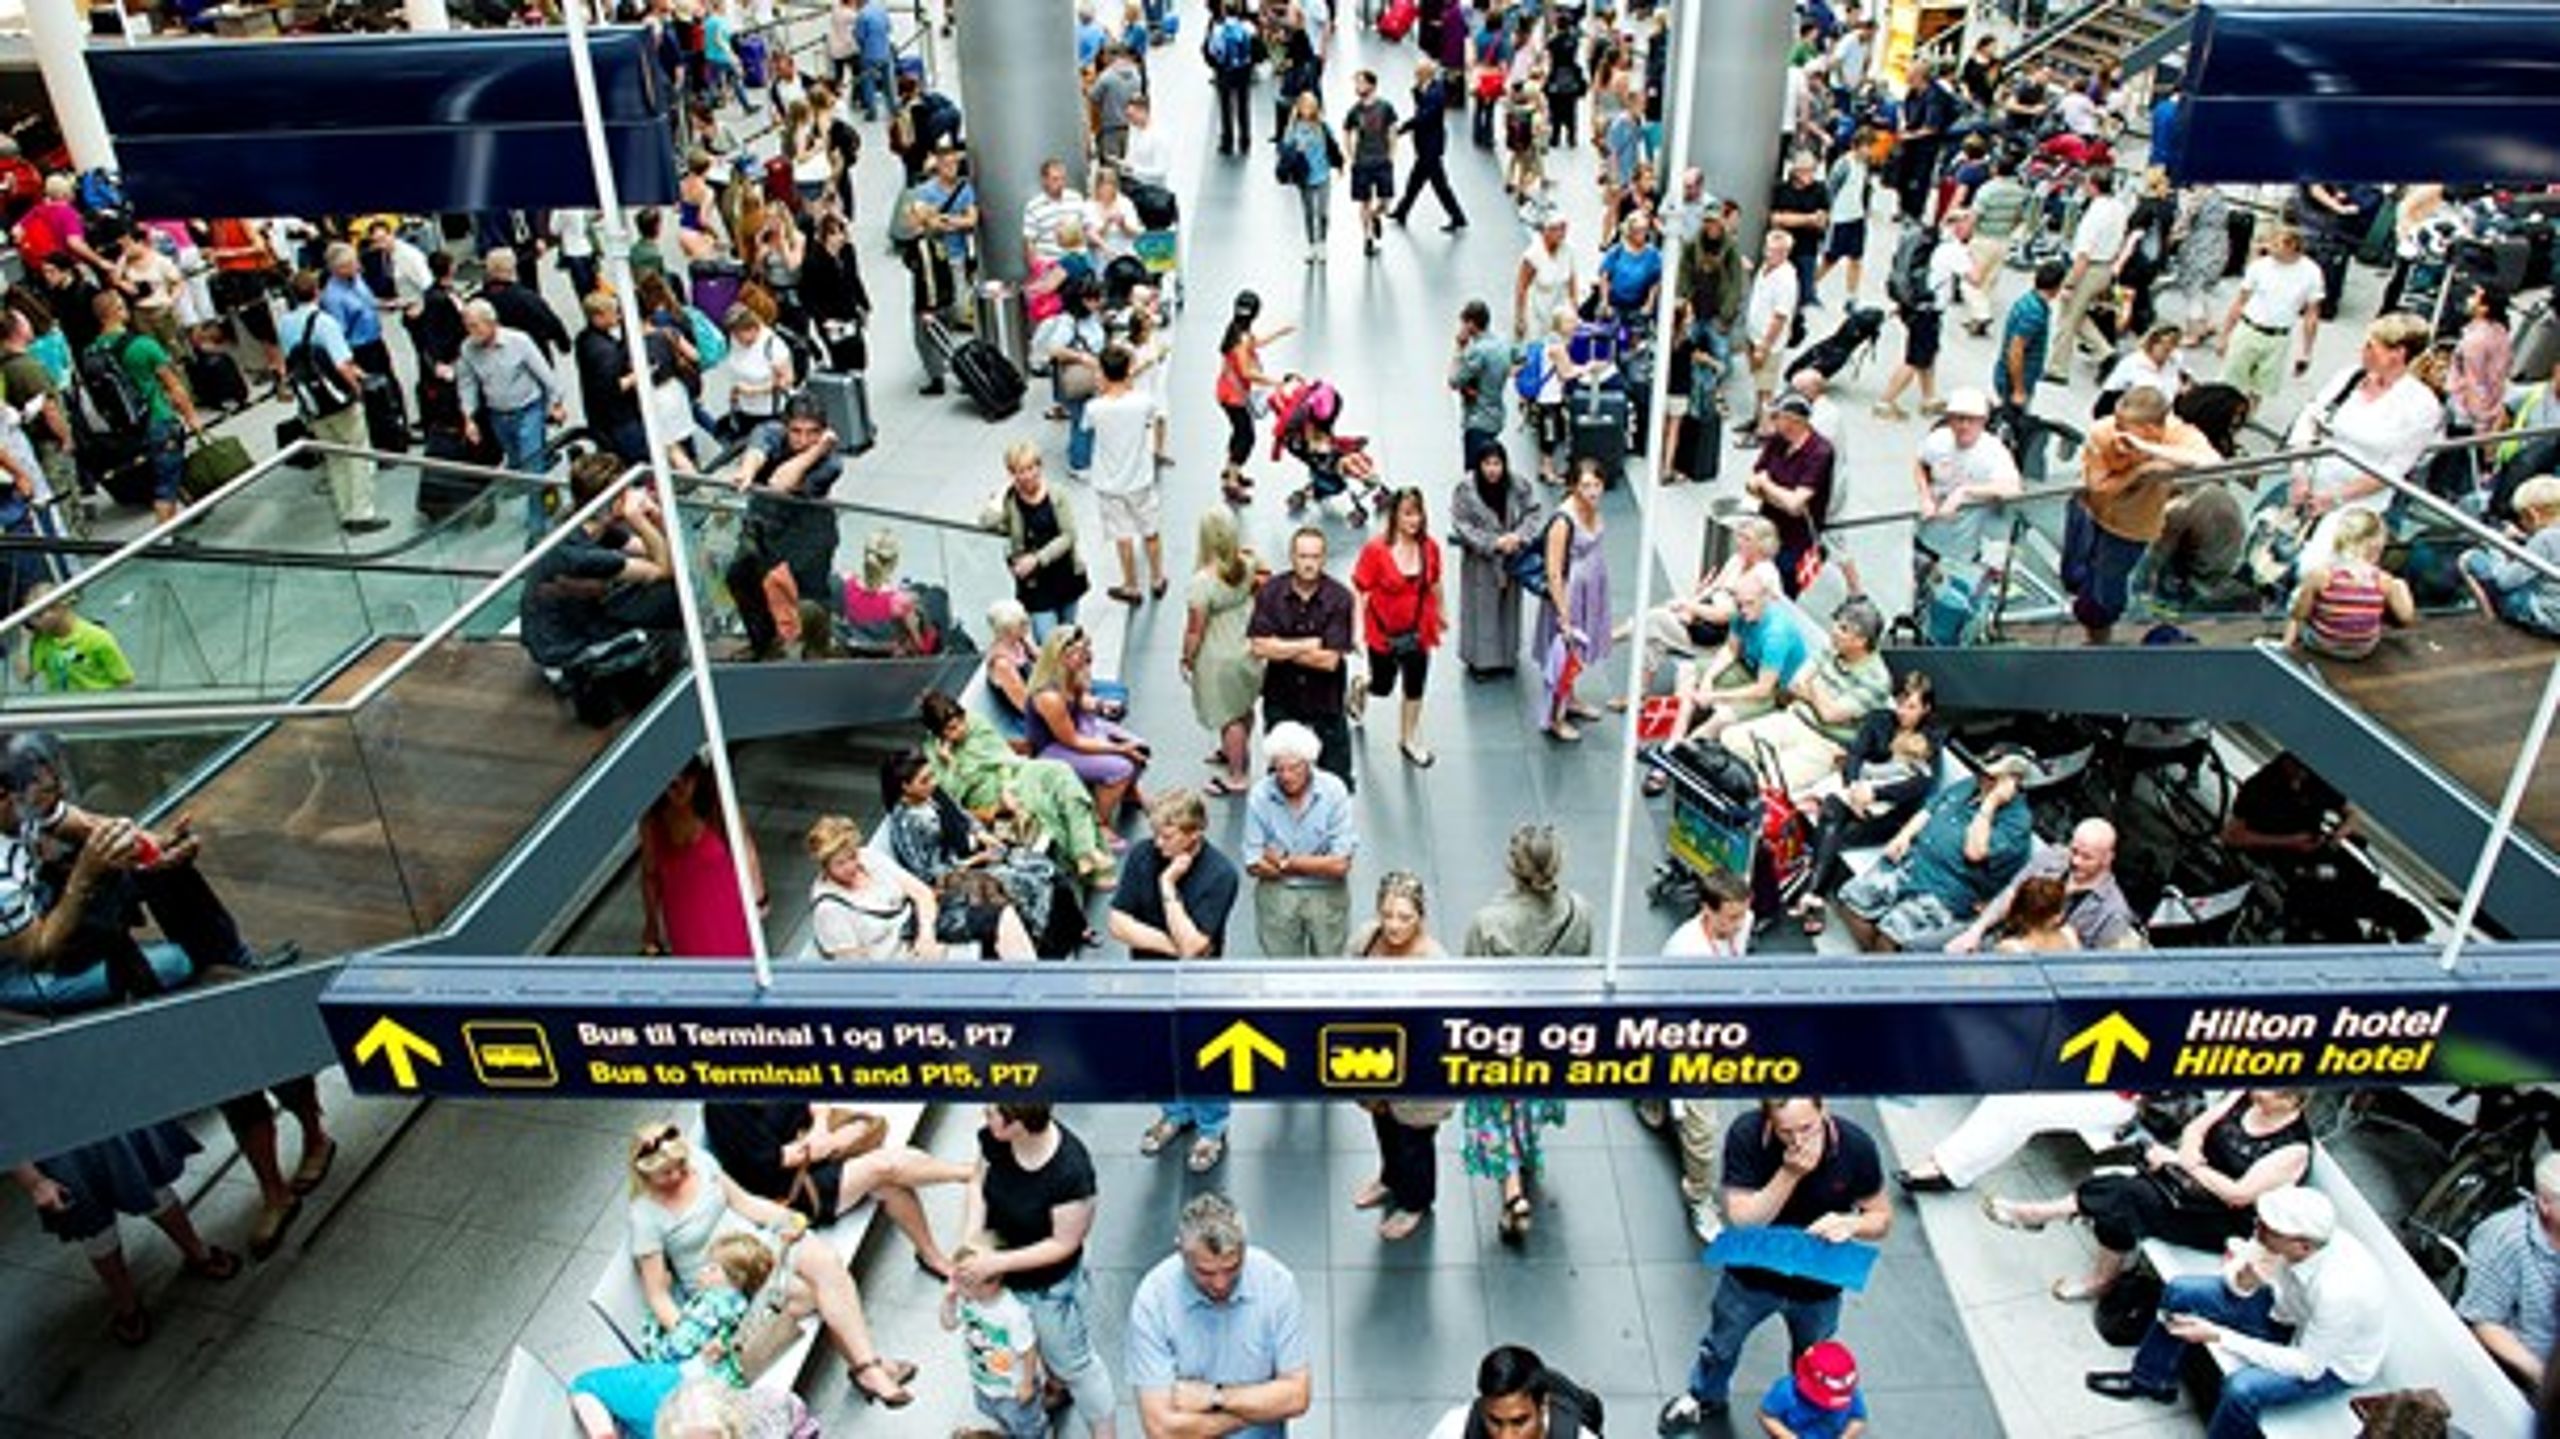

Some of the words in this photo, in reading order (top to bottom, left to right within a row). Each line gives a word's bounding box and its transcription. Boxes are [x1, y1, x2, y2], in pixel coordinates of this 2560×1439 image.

[577, 1022, 638, 1046] Bus
[644, 1022, 676, 1046] til
[679, 1022, 814, 1046] Terminal
[821, 1023, 835, 1046] 1
[843, 1027, 884, 1052] og
[964, 1023, 1014, 1047] P17
[1442, 1017, 1523, 1055] Tog
[1539, 1024, 1597, 1054] og
[1615, 1017, 1748, 1049] Metro
[2184, 1008, 2318, 1041] Hilton
[2331, 1003, 2449, 1038] hotel
[588, 1061, 647, 1084] Bus
[655, 1062, 687, 1084] to
[692, 1061, 823, 1085] Terminal
[830, 1063, 843, 1084] 1
[852, 1063, 910, 1085] and
[990, 1062, 1039, 1085] P17
[1441, 1055, 1551, 1085] Train
[1566, 1053, 1652, 1084] and
[1669, 1052, 1801, 1084] Metro
[2173, 1044, 2304, 1076] Hilton
[2317, 1040, 2434, 1073] hotel
